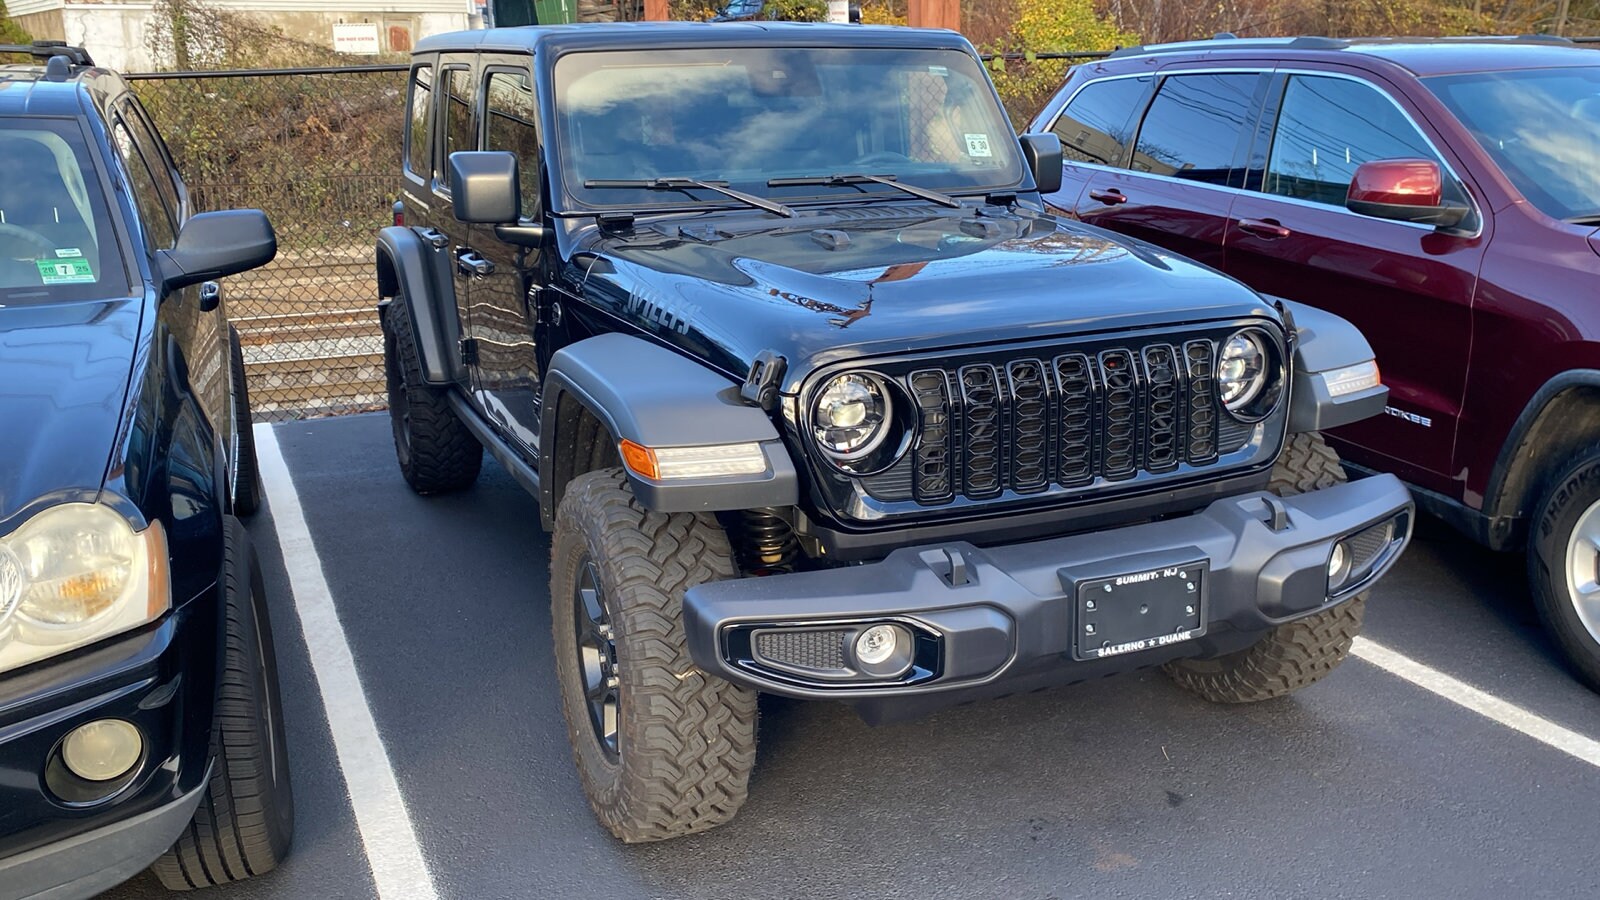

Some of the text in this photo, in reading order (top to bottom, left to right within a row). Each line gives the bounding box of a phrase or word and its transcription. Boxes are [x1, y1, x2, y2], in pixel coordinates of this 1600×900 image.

[970, 141, 976, 150] 6
[61, 265, 67, 274] 7
[1164, 568, 1177, 577] NJ
[1098, 631, 1191, 657] SALERNO DUANE
